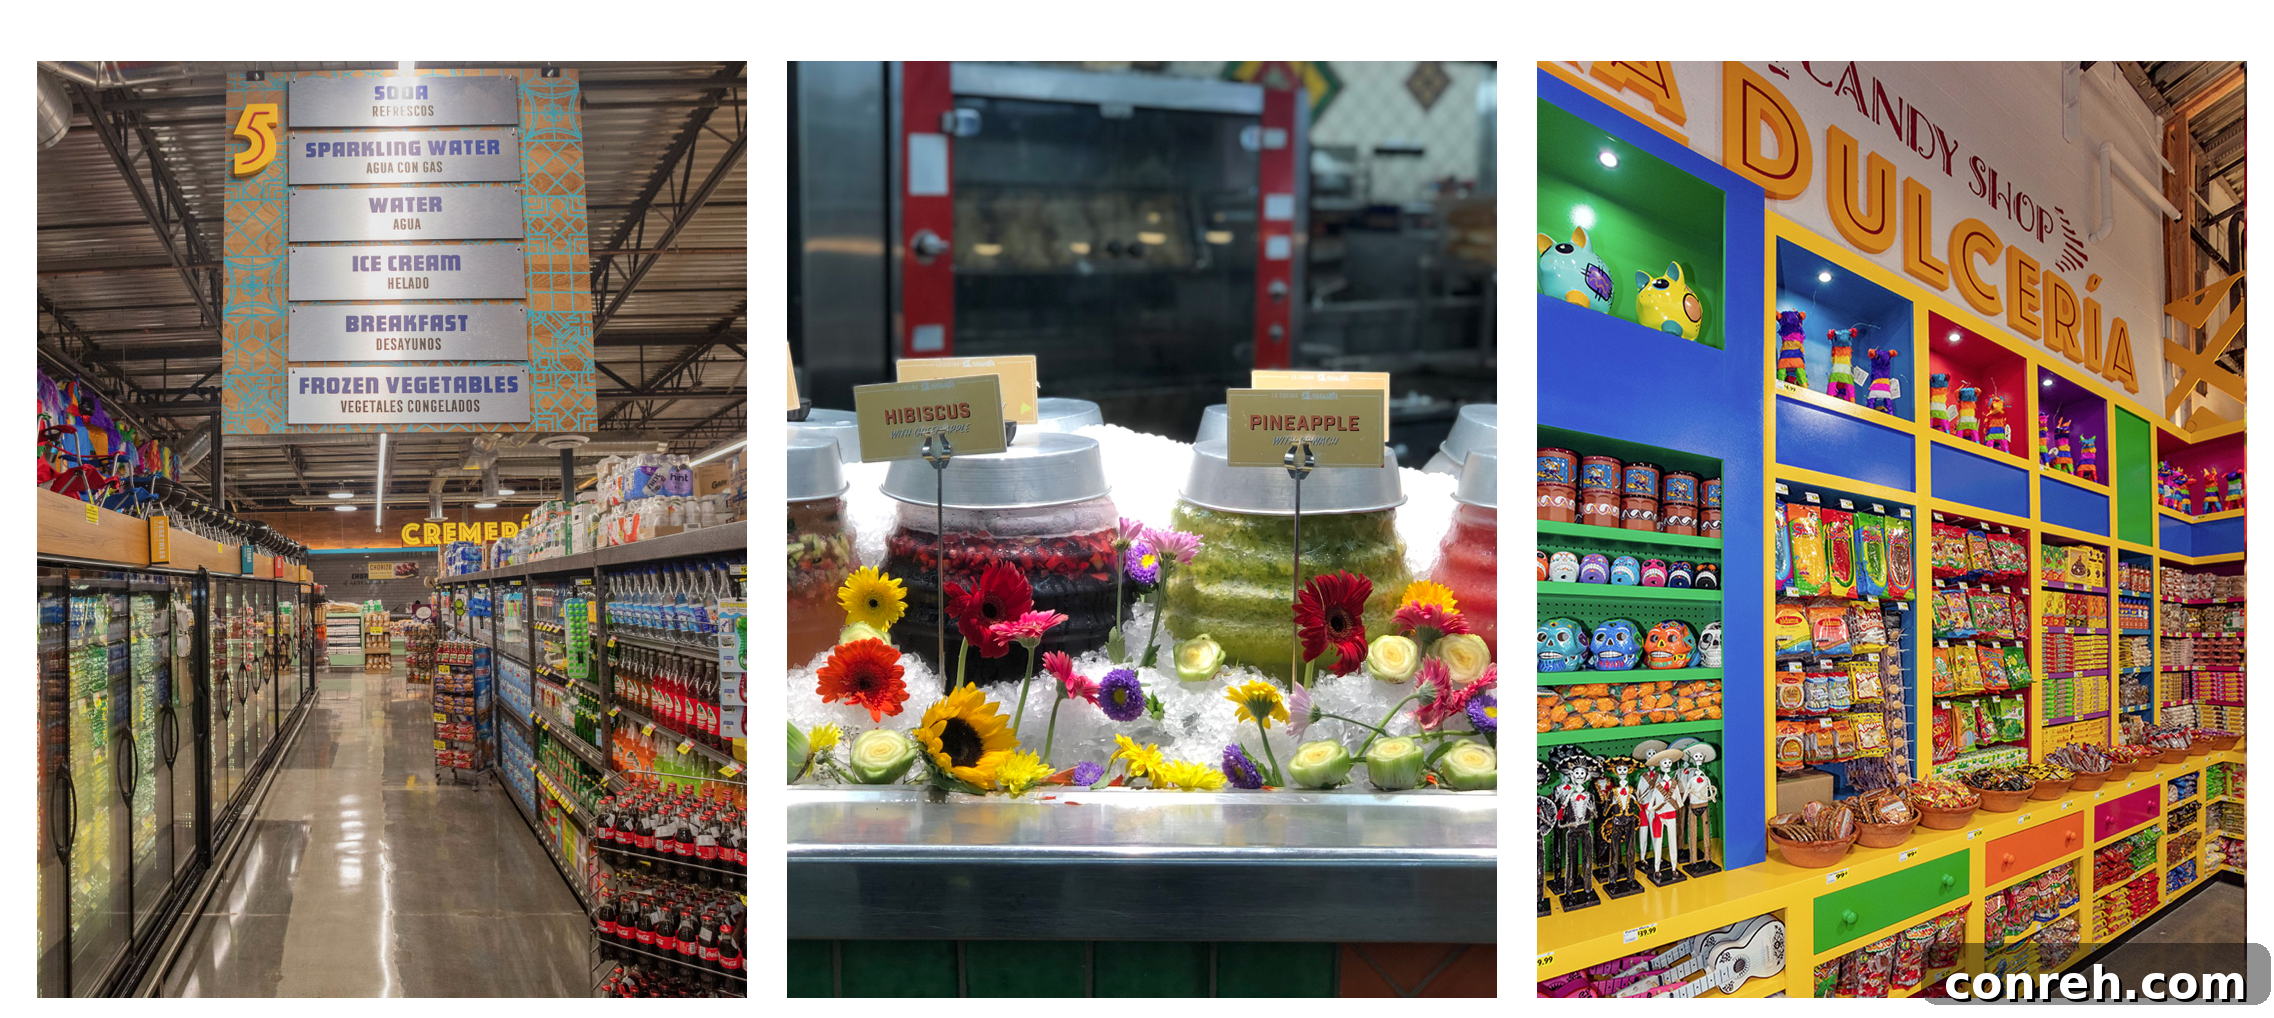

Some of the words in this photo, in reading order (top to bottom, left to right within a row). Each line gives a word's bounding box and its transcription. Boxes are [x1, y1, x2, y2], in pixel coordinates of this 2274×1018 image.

[374, 85, 428, 100] SODA
[372, 105, 434, 117] REFRESCOS
[234, 103, 278, 177] 5
[305, 141, 421, 158] SPARKLING
[427, 140, 500, 156] WATER
[366, 162, 394, 174] AGUA
[397, 162, 420, 174] CON
[422, 161, 443, 174] GAS
[368, 196, 443, 213] WATER
[1969, 155, 2054, 244] SHOP
[392, 218, 422, 231] AGUA
[1722, 61, 2140, 394] DULCERÍA
[352, 255, 382, 273] ICE
[388, 254, 461, 272] CREAM
[387, 277, 429, 290] HELADO
[345, 314, 469, 333] BREAKFAST
[375, 338, 442, 351] DESAYUNOS
[299, 376, 379, 395] FROZEN
[385, 375, 519, 394] VEGETABLES
[340, 400, 404, 413] VEGETALES
[407, 399, 481, 413] CONGELADOS
[884, 402, 971, 425] HIBISCUS
[890, 428, 912, 440] WITH
[944, 423, 972, 434] APPLE
[1250, 414, 1360, 432] PINEAPPLE
[1272, 436, 1295, 446] WITH
[670, 473, 689, 482] hint
[1638, 926, 1657, 938] $39.99
